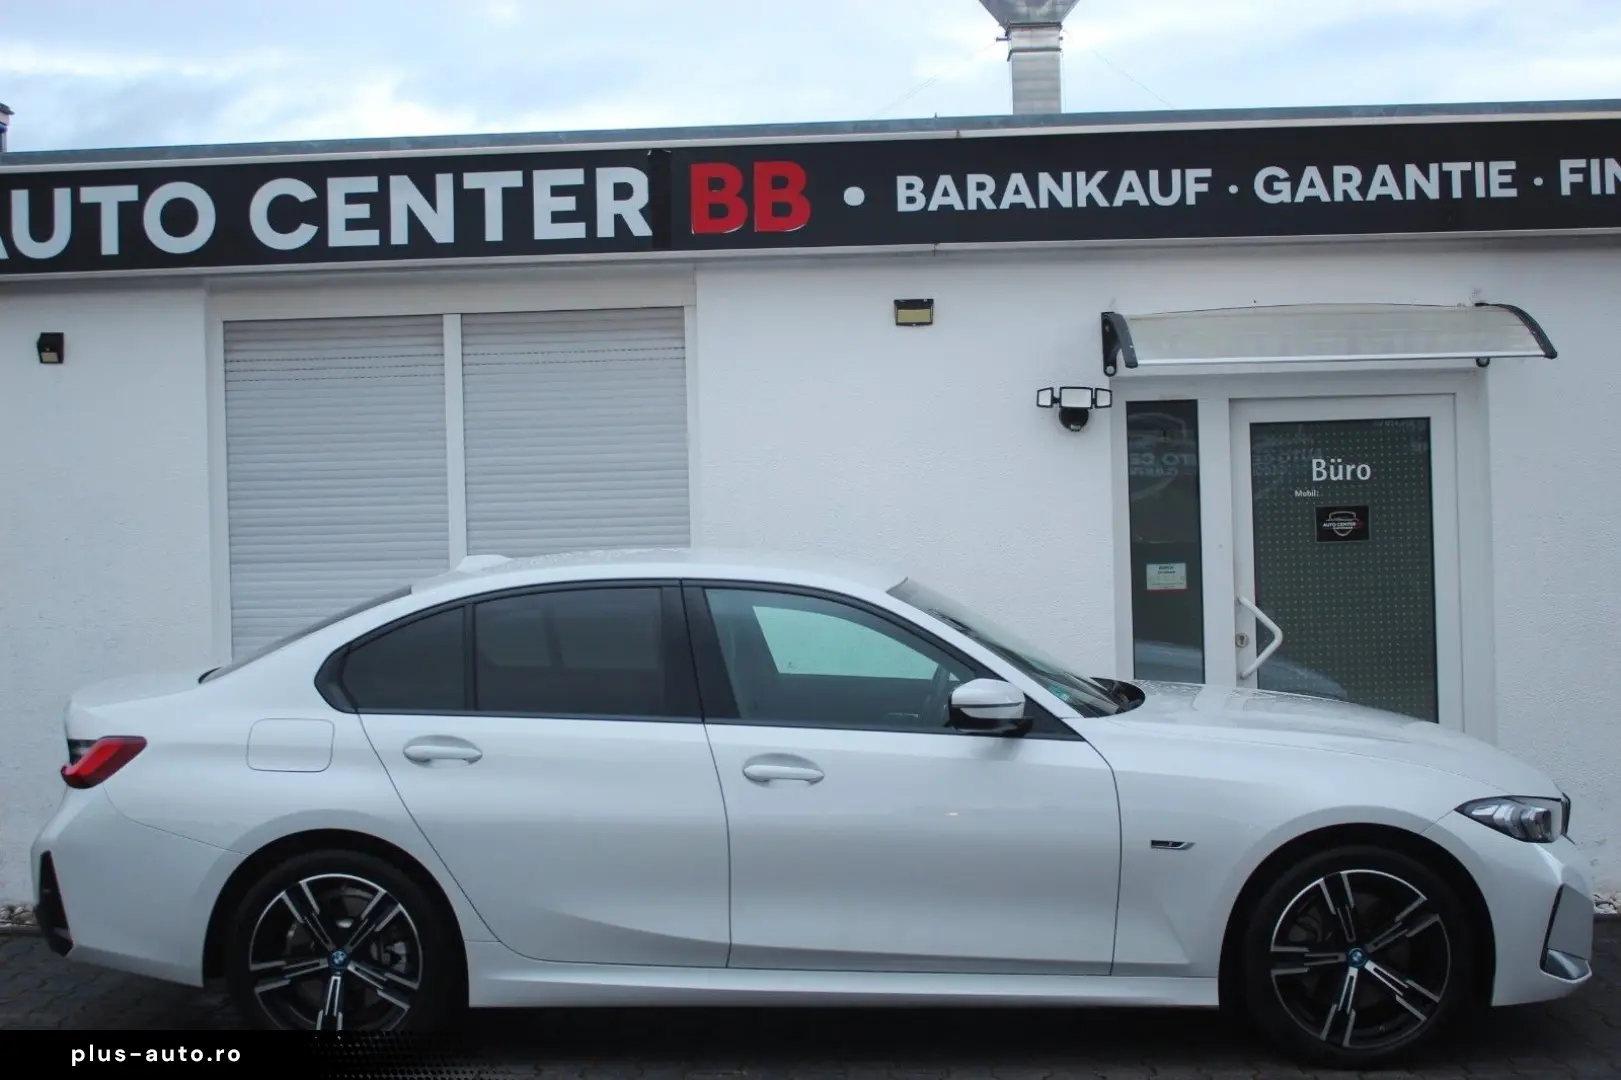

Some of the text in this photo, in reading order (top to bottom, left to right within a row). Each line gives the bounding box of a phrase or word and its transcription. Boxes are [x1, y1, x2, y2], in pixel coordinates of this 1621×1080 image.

[896, 168, 1213, 213] BARANKAUF
[1254, 160, 1518, 204] GARANTIE
[0, 161, 811, 260] UTO CENTER BB
[1311, 458, 1371, 483] Büro
[1294, 489, 1319, 498] Mobil:
